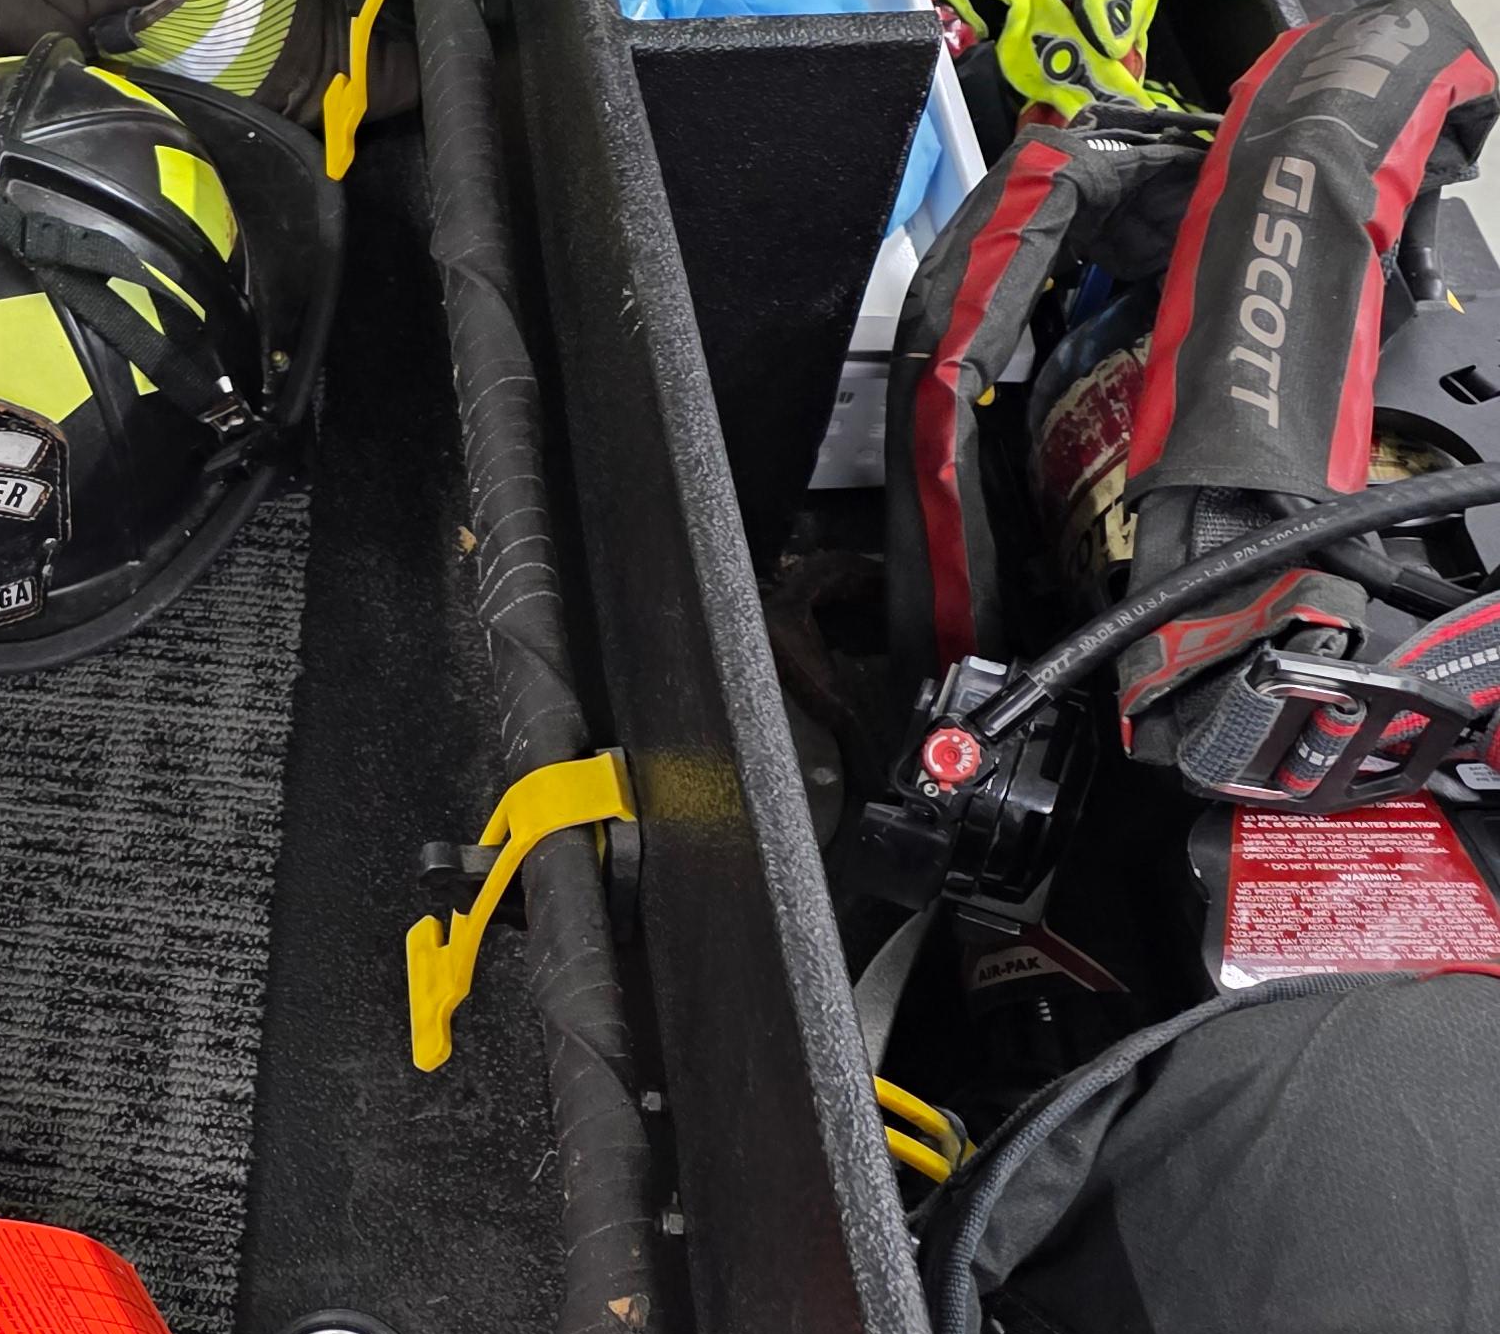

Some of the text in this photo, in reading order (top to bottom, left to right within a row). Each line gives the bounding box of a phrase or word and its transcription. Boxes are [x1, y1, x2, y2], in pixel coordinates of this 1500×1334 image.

[1229, 214, 1304, 430] SCOTT
[1079, 622, 1115, 654] MADE
[1116, 611, 1134, 628] IN
[1234, 543, 1257, 563] P/N
[958, 739, 978, 774] PURGE
[978, 956, 1042, 984] AIR-PAK
